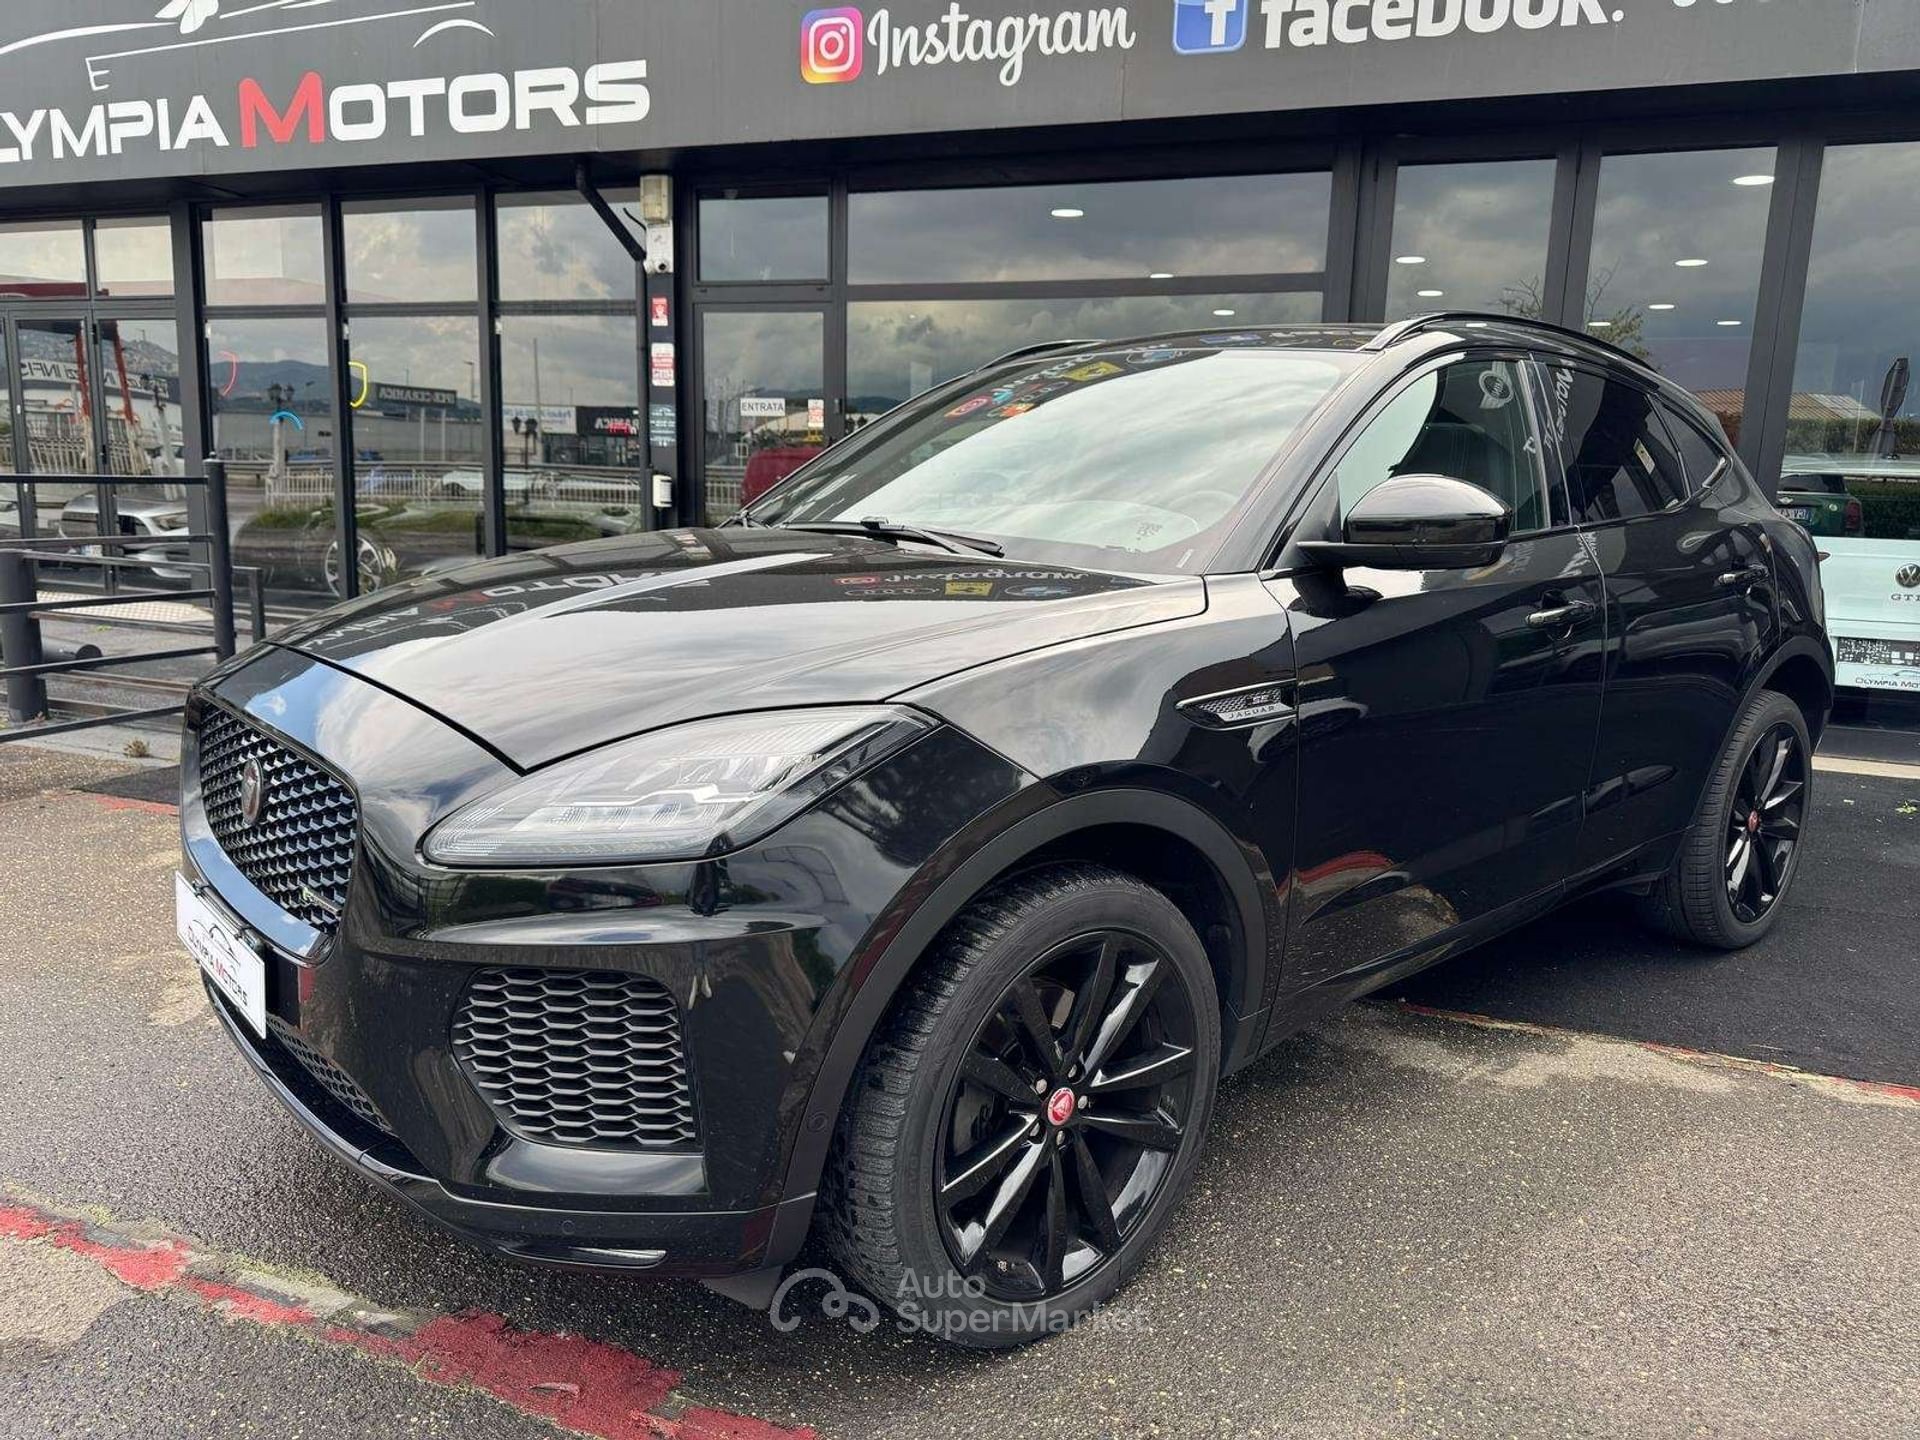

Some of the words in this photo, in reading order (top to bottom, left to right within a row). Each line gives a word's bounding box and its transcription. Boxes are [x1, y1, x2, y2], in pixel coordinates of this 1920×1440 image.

[867, 2, 1136, 86] Instagram
[238, 59, 650, 148] MOTORS
[741, 402, 785, 413] ENTRATA
[1230, 705, 1274, 718] JAGUAR
